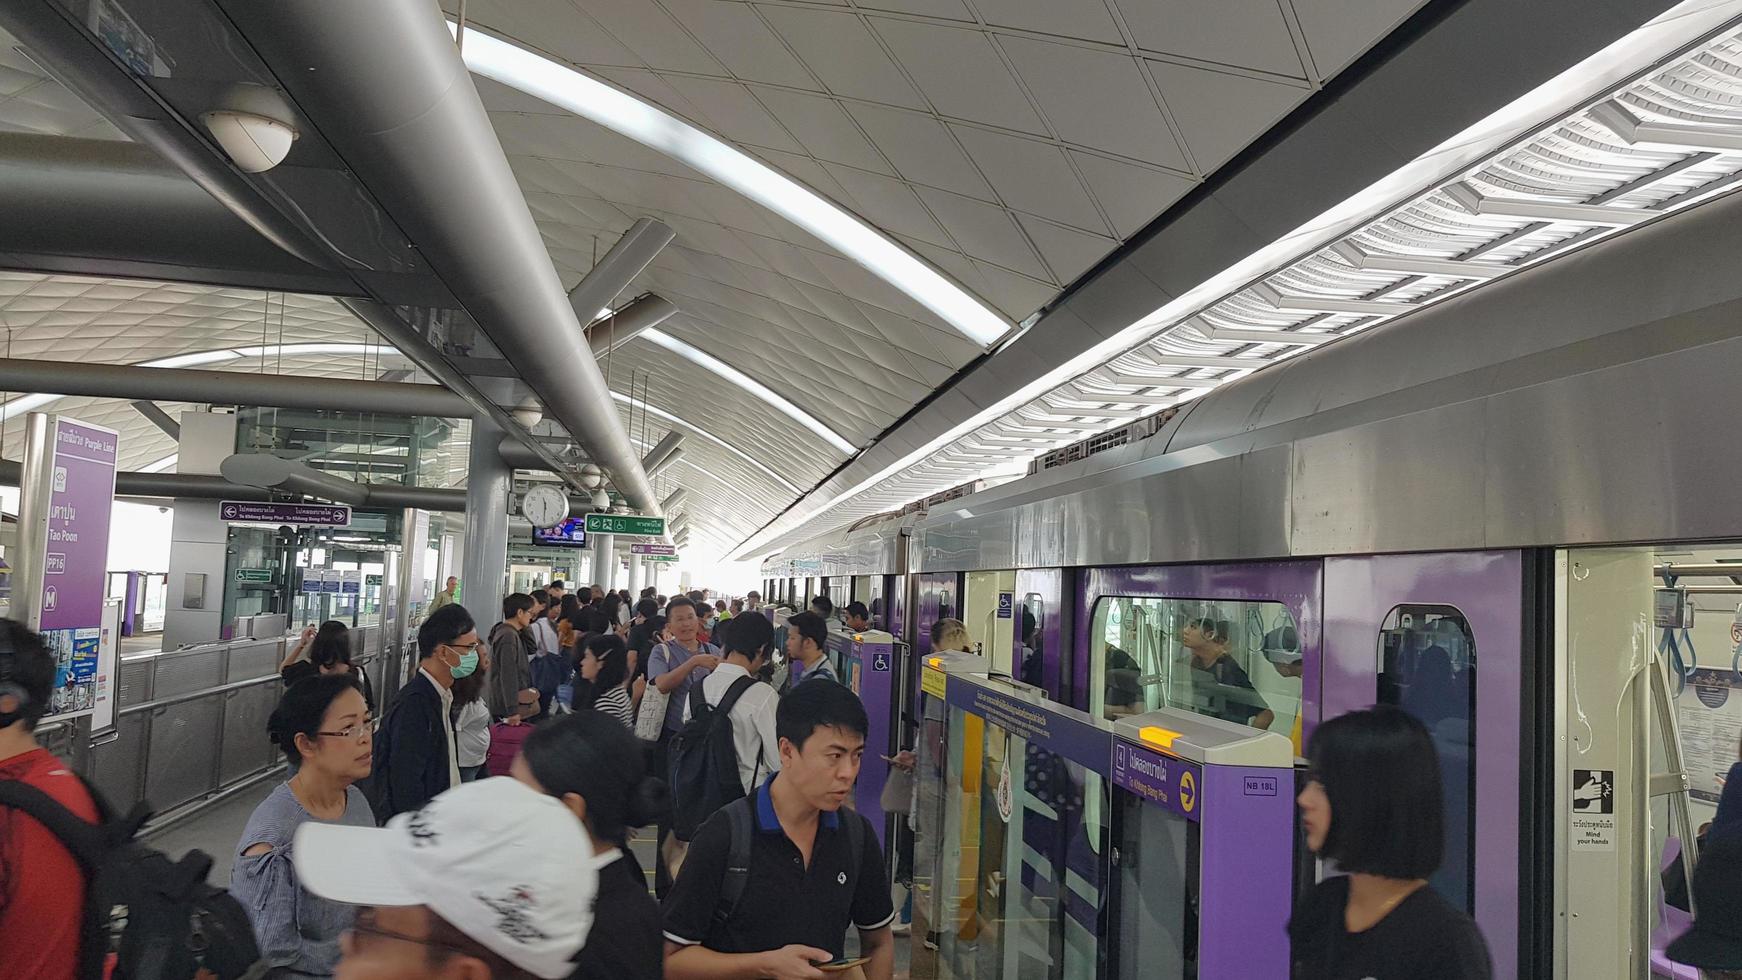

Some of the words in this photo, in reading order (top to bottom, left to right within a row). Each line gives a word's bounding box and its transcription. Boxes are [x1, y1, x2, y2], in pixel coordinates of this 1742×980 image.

[84, 437, 102, 452] Purple
[103, 441, 115, 454] Line
[51, 502, 76, 526] เตาปูน
[49, 528, 61, 541] Tao
[61, 529, 78, 542] Poon
[47, 558, 64, 569] PP16
[1129, 747, 1167, 783] ไปคลองบางไผ่
[1148, 784, 1158, 801] Bang
[1158, 788, 1168, 803] Phai
[1246, 782, 1258, 790] NB
[1261, 782, 1275, 791] 18L
